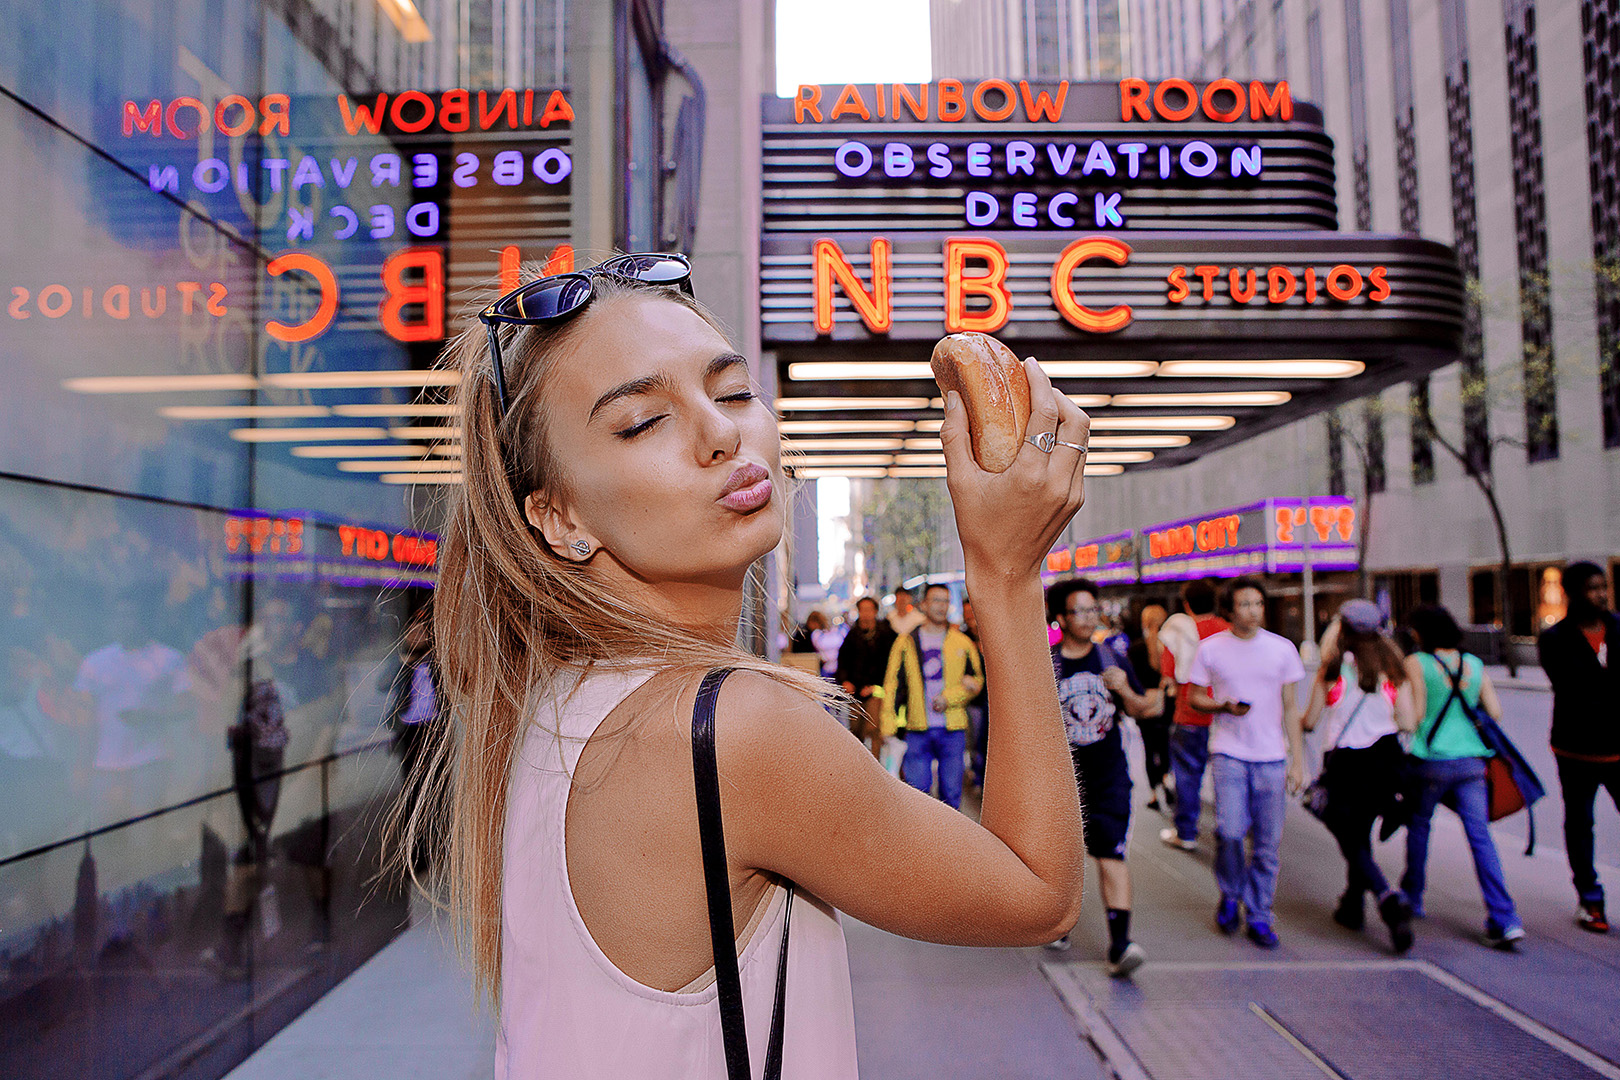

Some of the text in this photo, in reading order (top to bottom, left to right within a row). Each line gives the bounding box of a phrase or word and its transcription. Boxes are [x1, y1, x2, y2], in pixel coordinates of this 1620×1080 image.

[794, 77, 1294, 125] RAINBOW ROOM
[835, 139, 1262, 180] OBSERVATION
[965, 190, 1124, 228] DECK
[811, 237, 1392, 334] NBC STUDIOS
